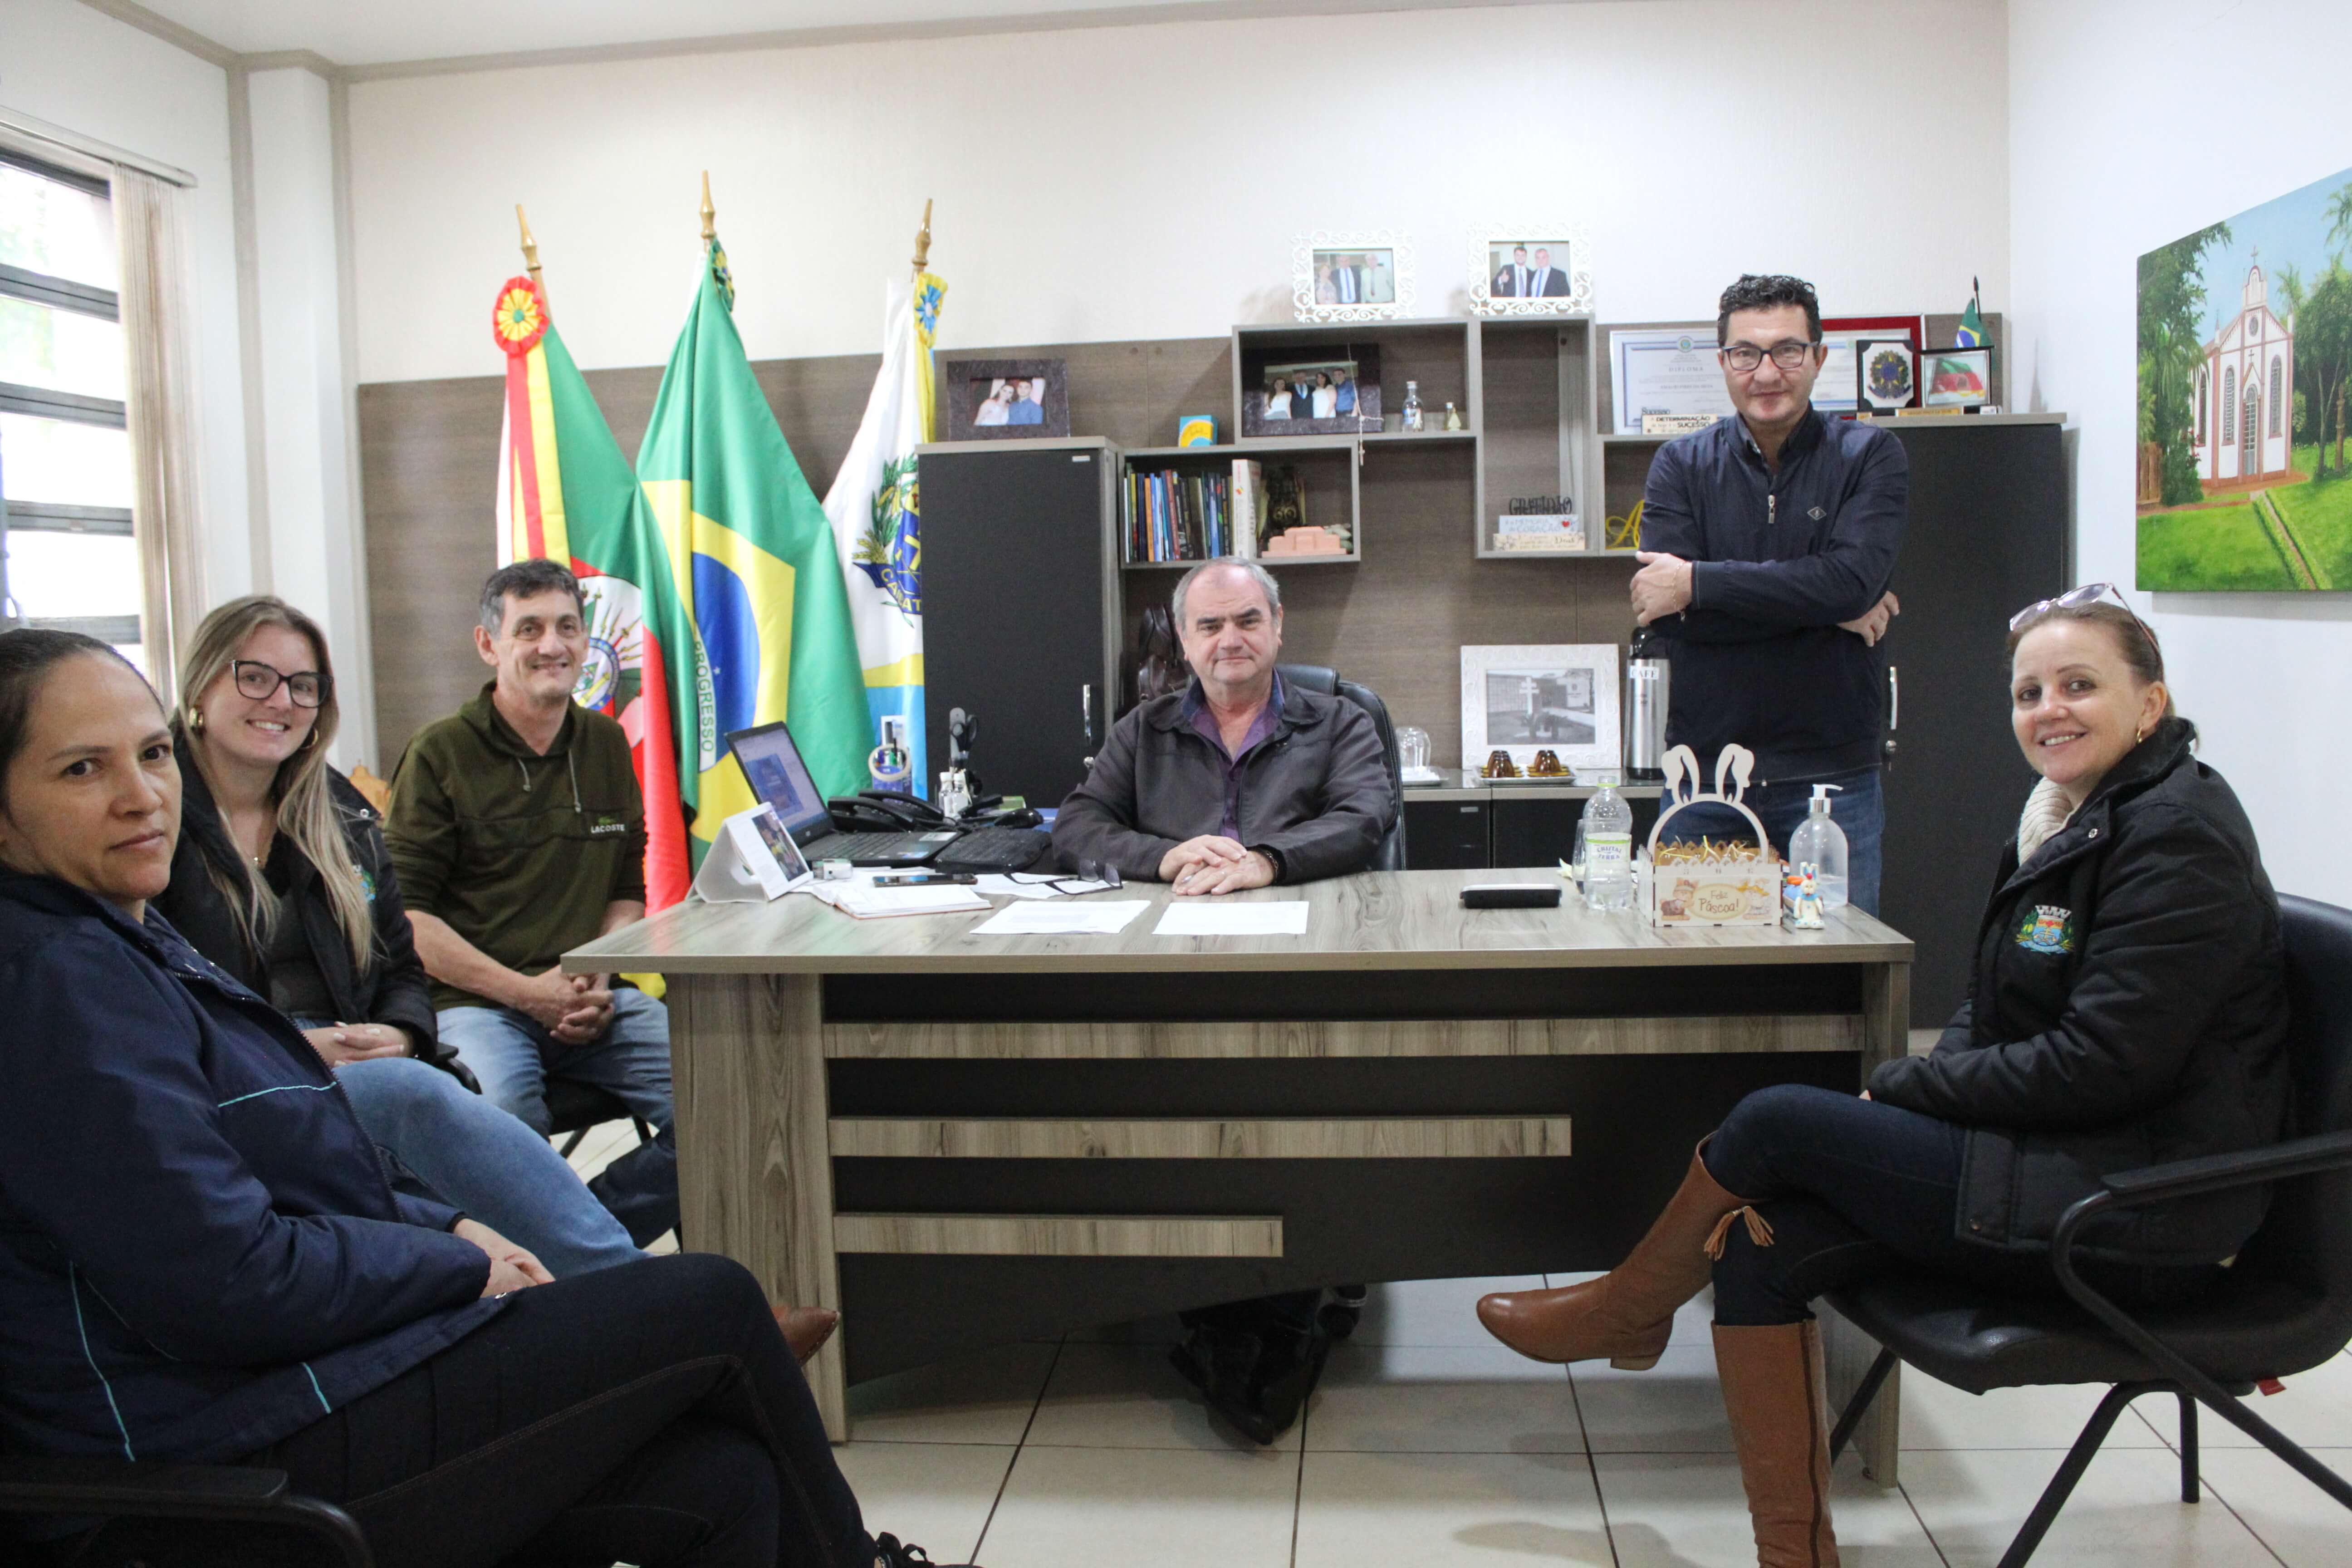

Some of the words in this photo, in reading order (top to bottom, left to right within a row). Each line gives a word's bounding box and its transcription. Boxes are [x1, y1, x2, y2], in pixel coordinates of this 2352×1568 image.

[1631, 668, 1657, 677] CAFÉ
[695, 642, 714, 751] PROGRESSO
[591, 823, 625, 834] LACOSTE
[1711, 890, 1728, 900] Feliz
[1698, 898, 1739, 914] Páscoa!
